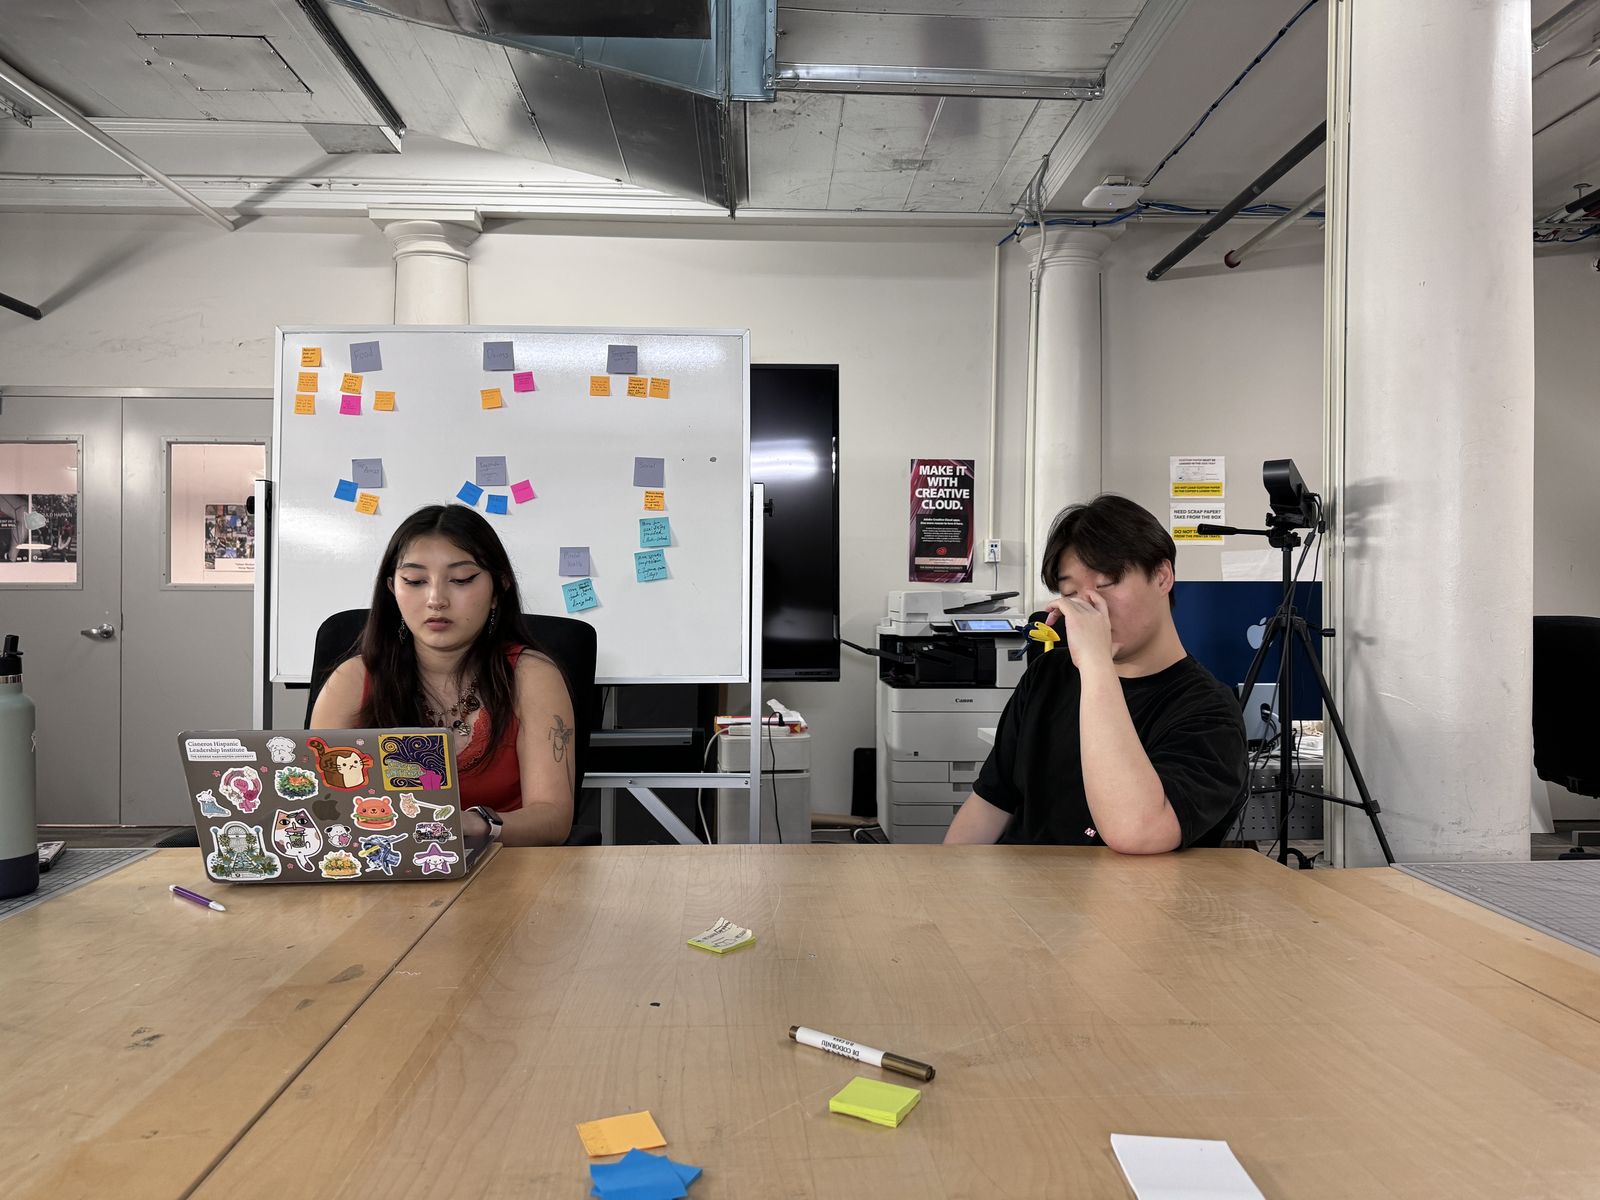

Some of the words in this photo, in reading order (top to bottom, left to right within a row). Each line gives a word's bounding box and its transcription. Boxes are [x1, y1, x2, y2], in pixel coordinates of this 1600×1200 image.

[920, 466, 954, 476] MAKE
[956, 466, 967, 476] IT
[928, 477, 958, 487] WITH
[915, 488, 970, 498] CREATIVE
[922, 500, 963, 510] CLOUD.
